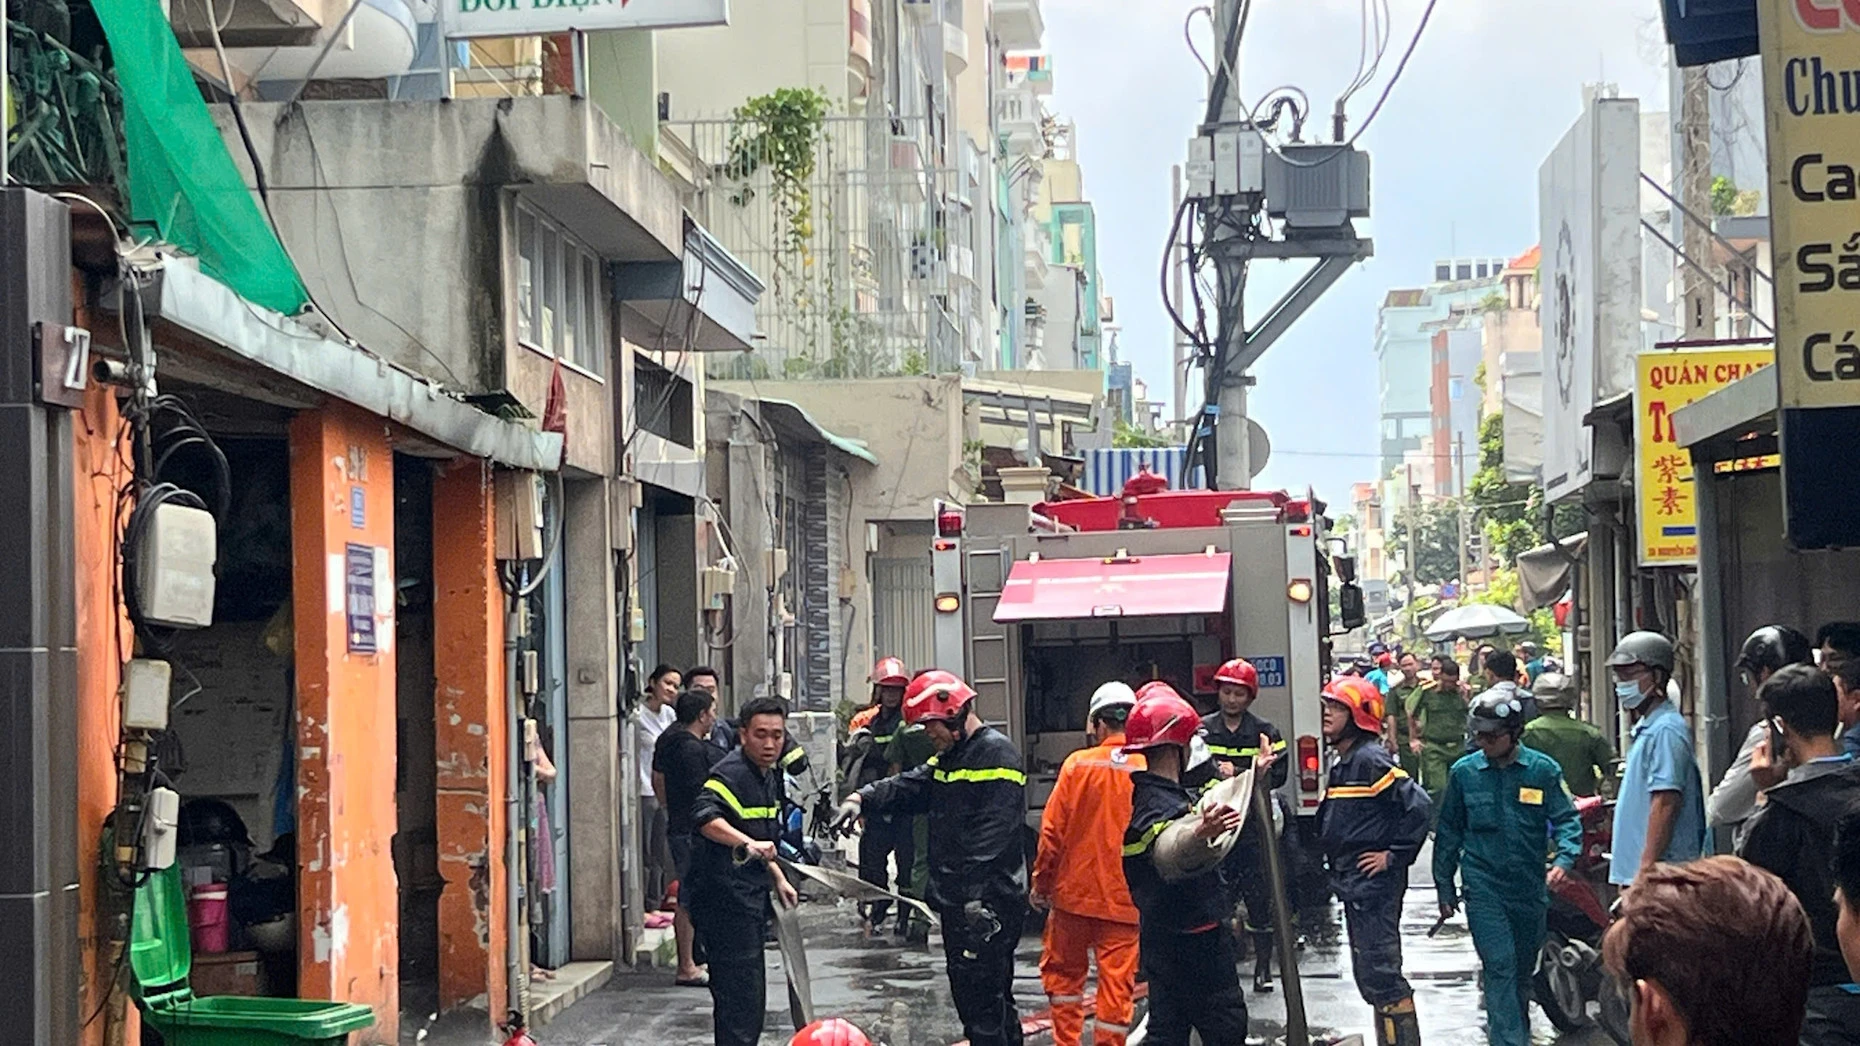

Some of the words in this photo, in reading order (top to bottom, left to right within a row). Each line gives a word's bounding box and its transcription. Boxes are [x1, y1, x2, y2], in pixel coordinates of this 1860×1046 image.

[64, 326, 91, 390] 7
[1650, 360, 1708, 390] QUÁN
[1651, 454, 1688, 516] 紫素
